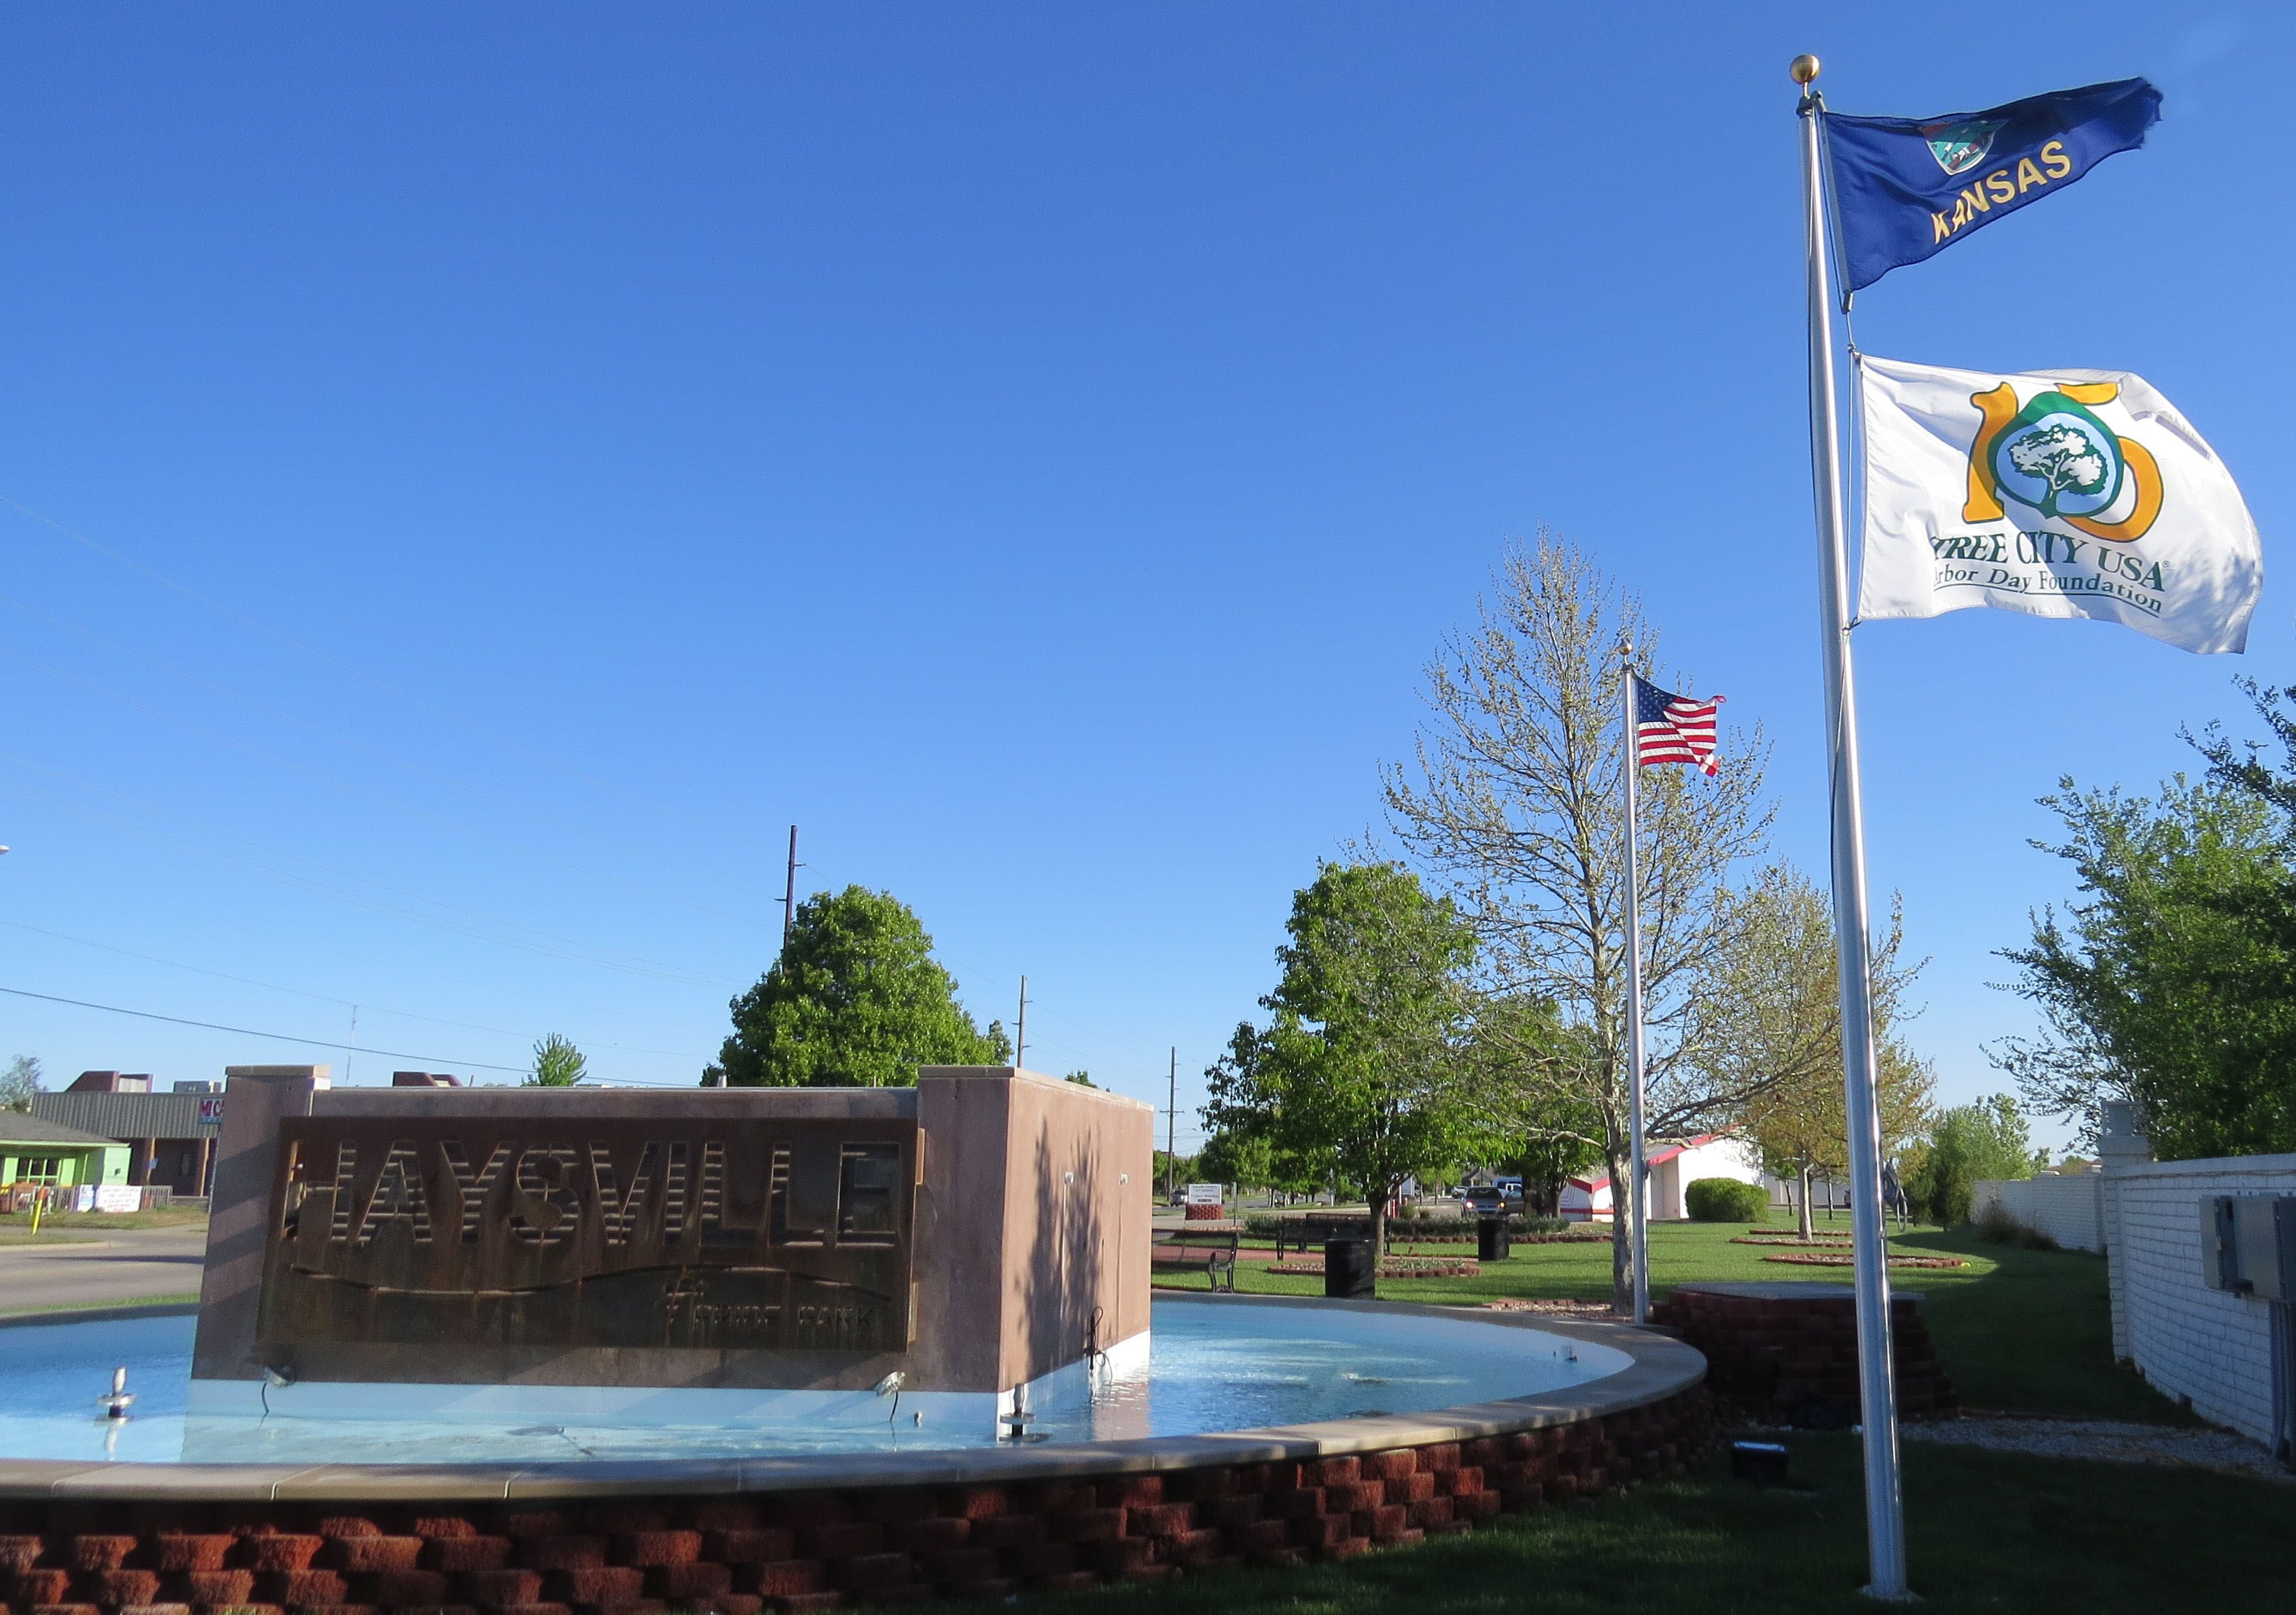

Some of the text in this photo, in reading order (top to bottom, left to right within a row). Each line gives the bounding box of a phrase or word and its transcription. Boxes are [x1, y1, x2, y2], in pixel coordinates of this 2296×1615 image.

[1931, 140, 2072, 244] KANSAS
[1930, 531, 2165, 592] TREE CITY USA
[1987, 568, 2032, 594] Day
[2039, 570, 2163, 614] Foundation
[280, 1140, 902, 1248] HAYSVILLE
[799, 1305, 874, 1326] PARK
